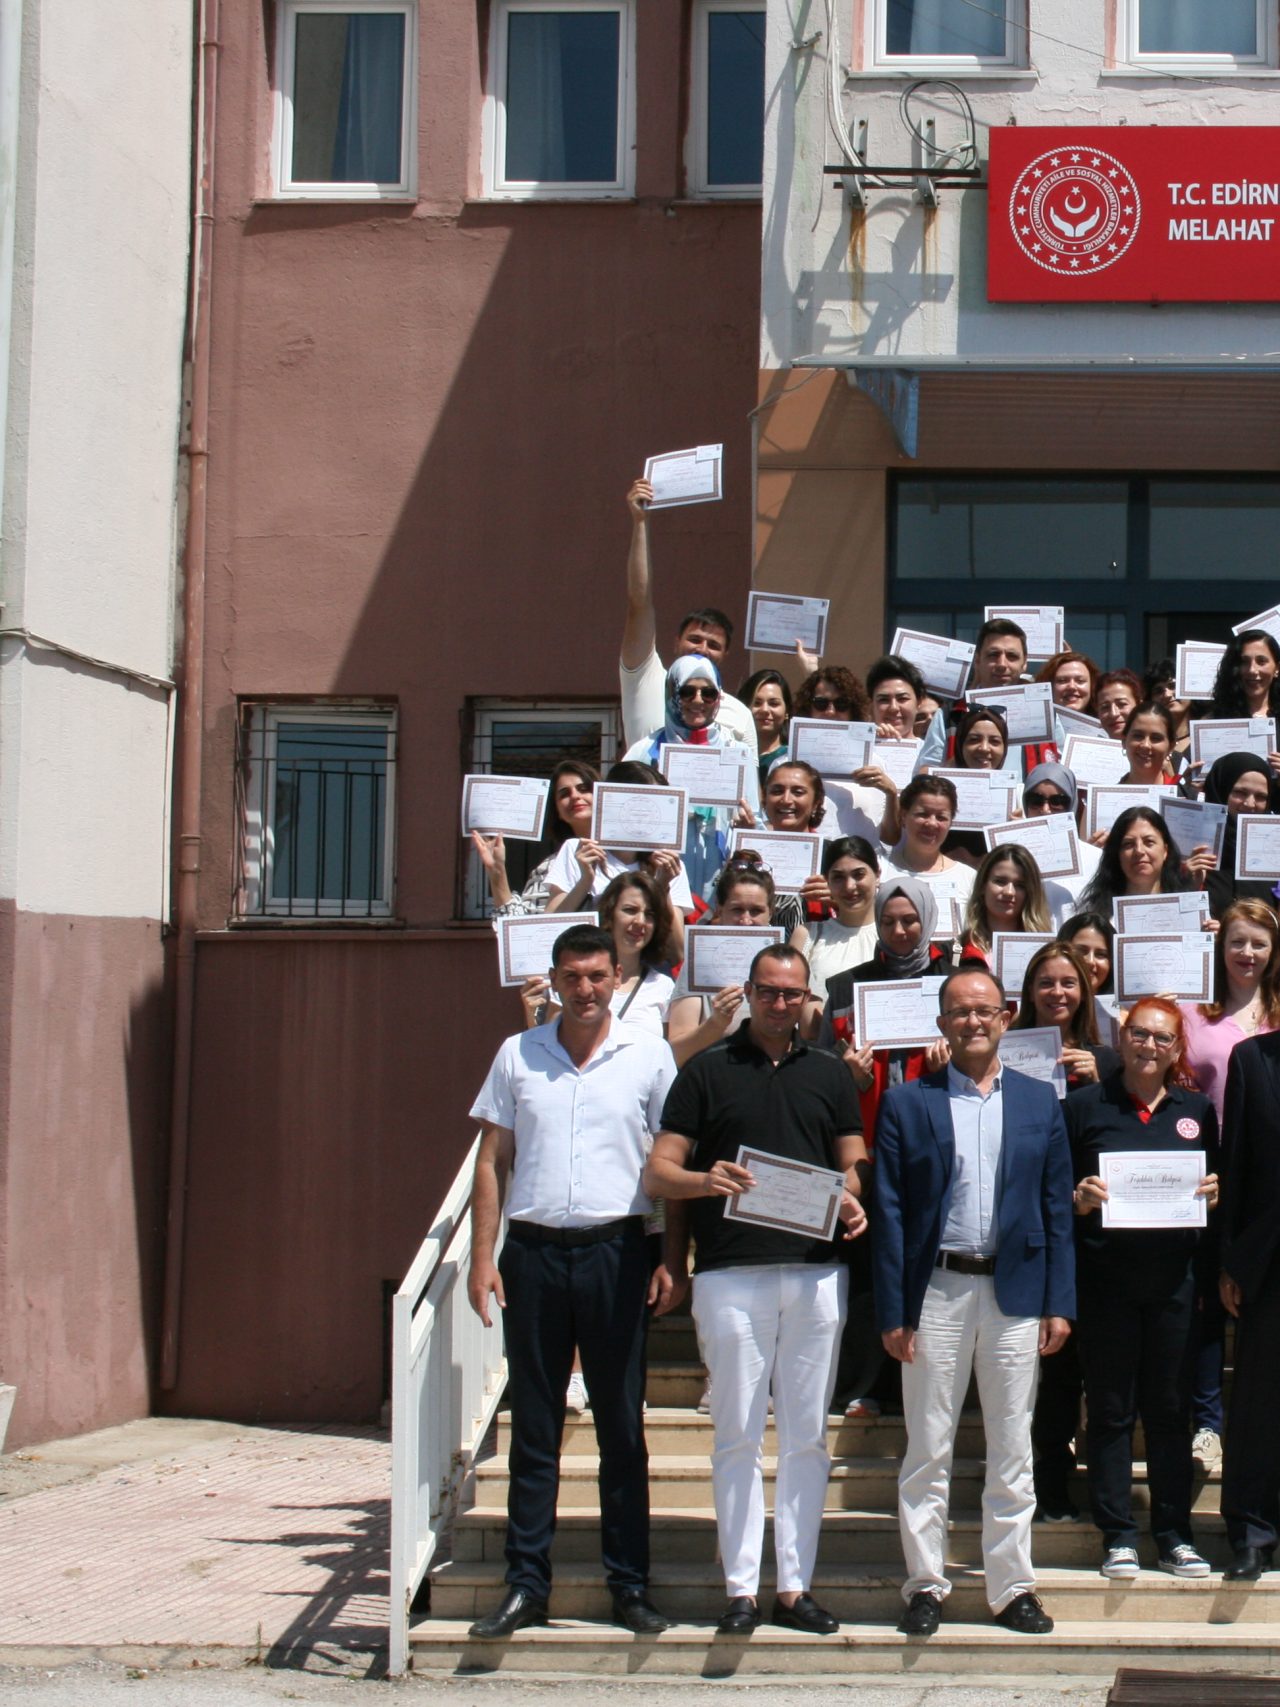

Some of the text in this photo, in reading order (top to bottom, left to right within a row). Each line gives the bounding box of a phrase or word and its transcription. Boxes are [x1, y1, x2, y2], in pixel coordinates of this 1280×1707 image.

[1050, 171, 1065, 183] AİLE
[1076, 169, 1102, 184] SOSYAL
[1033, 181, 1051, 228] CUMHURİYETİ
[1101, 181, 1118, 221] HİZMETLER
[1167, 183, 1206, 205] T.C.
[1039, 229, 1065, 251] TÜRKİYE
[1083, 221, 1116, 251] BAKANLIĞI
[1168, 218, 1275, 241] MELAHAT
